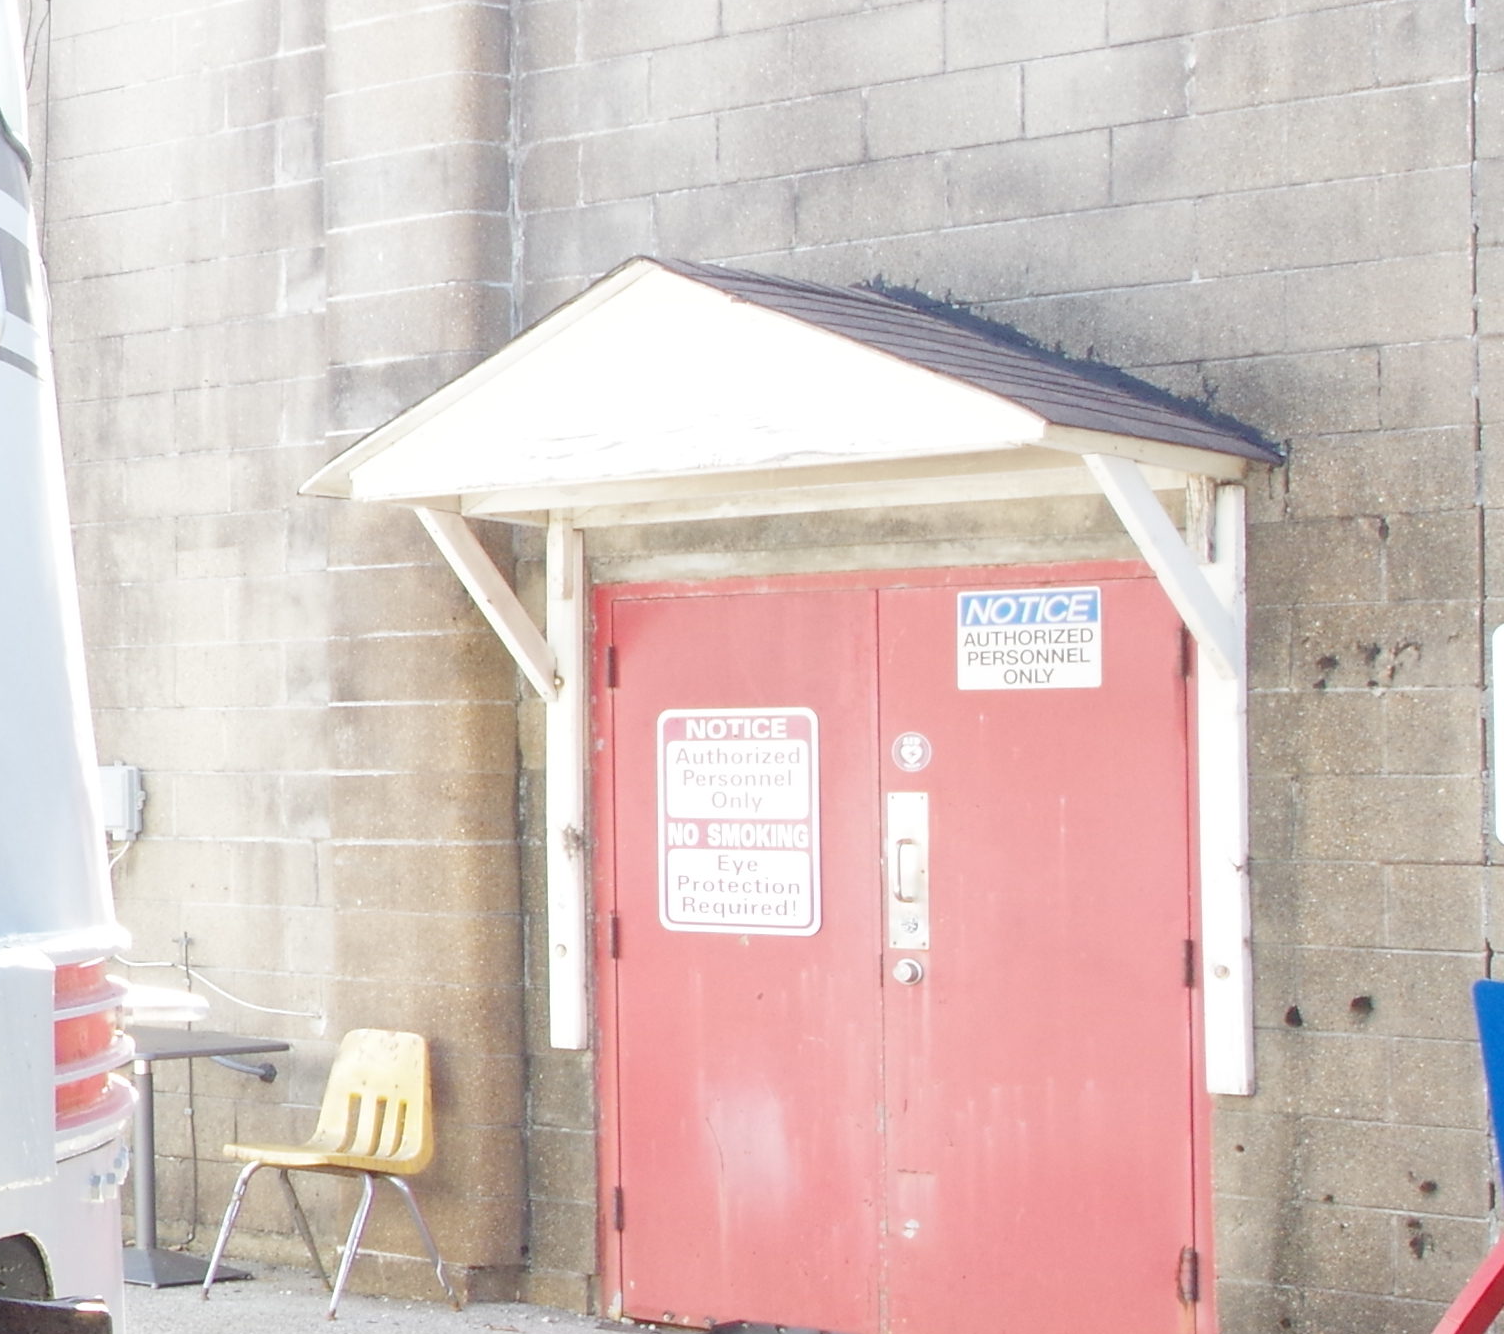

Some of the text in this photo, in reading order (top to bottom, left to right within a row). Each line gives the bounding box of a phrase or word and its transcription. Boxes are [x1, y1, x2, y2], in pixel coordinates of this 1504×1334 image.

[965, 594, 1093, 625] NOTICE
[963, 627, 1094, 648] AUTHORIZED
[967, 647, 1091, 666] PERSONNEL
[1003, 667, 1055, 685] ONLY
[686, 718, 787, 739] NOTICE
[675, 747, 801, 765] Authorized
[682, 769, 793, 787] Personnel
[711, 791, 763, 813] Only
[667, 823, 809, 848] NO SMOKING
[717, 854, 759, 876] Eye
[677, 875, 801, 895] Protection
[682, 896, 797, 918] Required!
